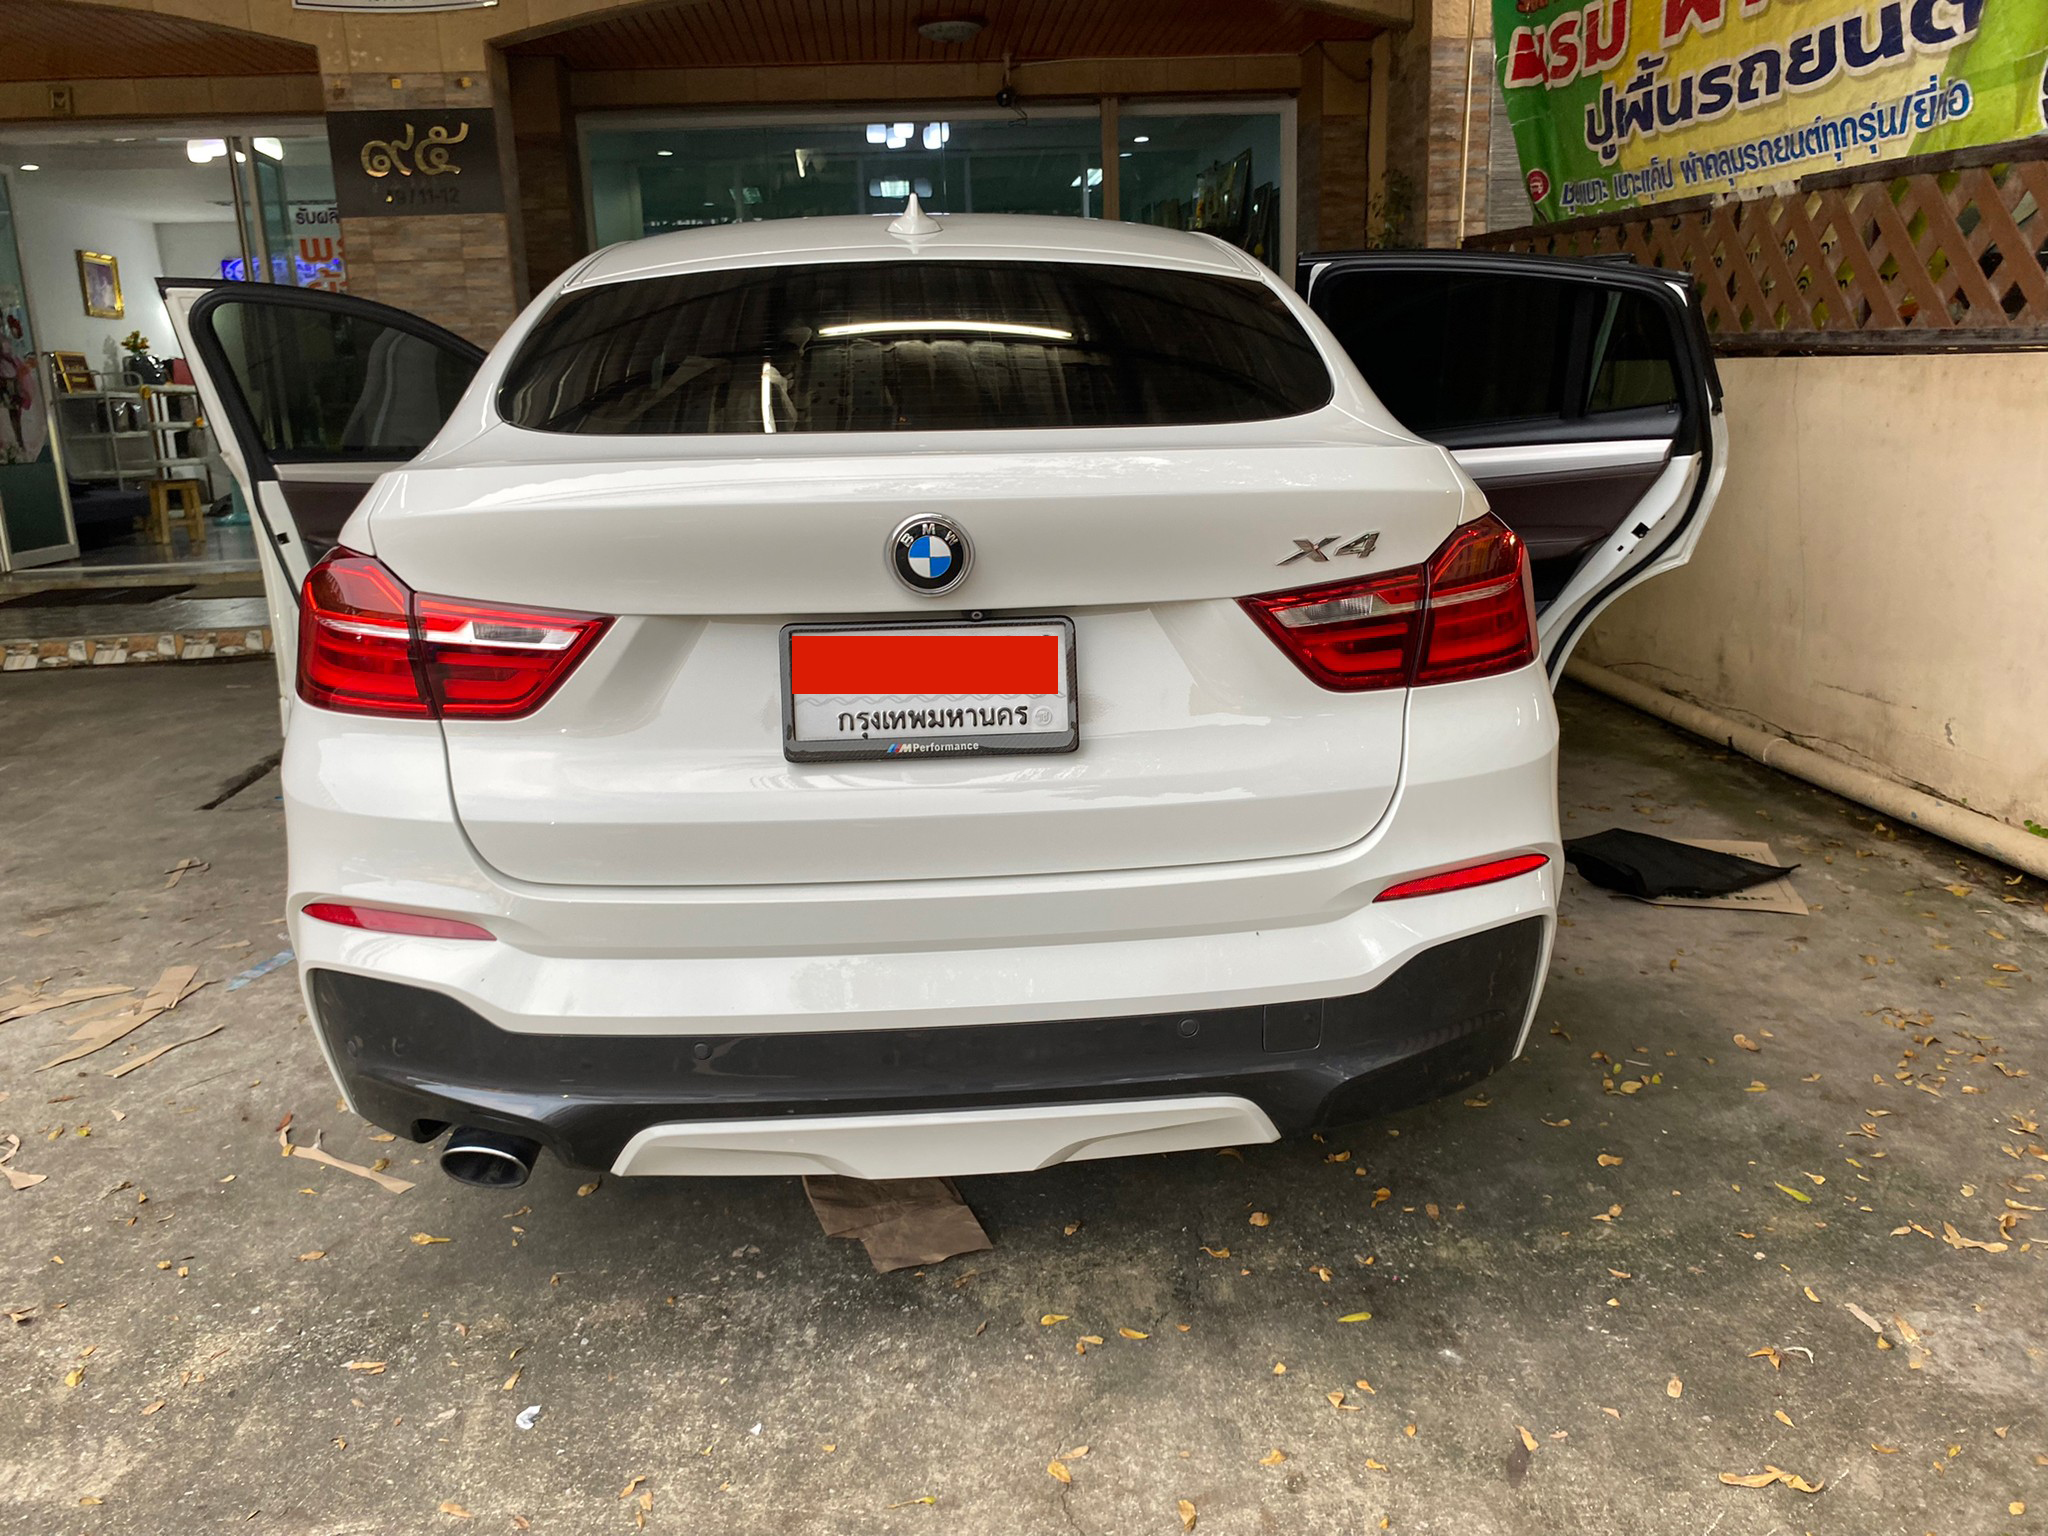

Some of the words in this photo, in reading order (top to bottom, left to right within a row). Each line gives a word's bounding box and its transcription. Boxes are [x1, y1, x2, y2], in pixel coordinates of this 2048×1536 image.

[899, 524, 960, 548] BMW
[1275, 530, 1381, 567] X4
[837, 704, 1029, 740] กรุงเทพมหานคร
